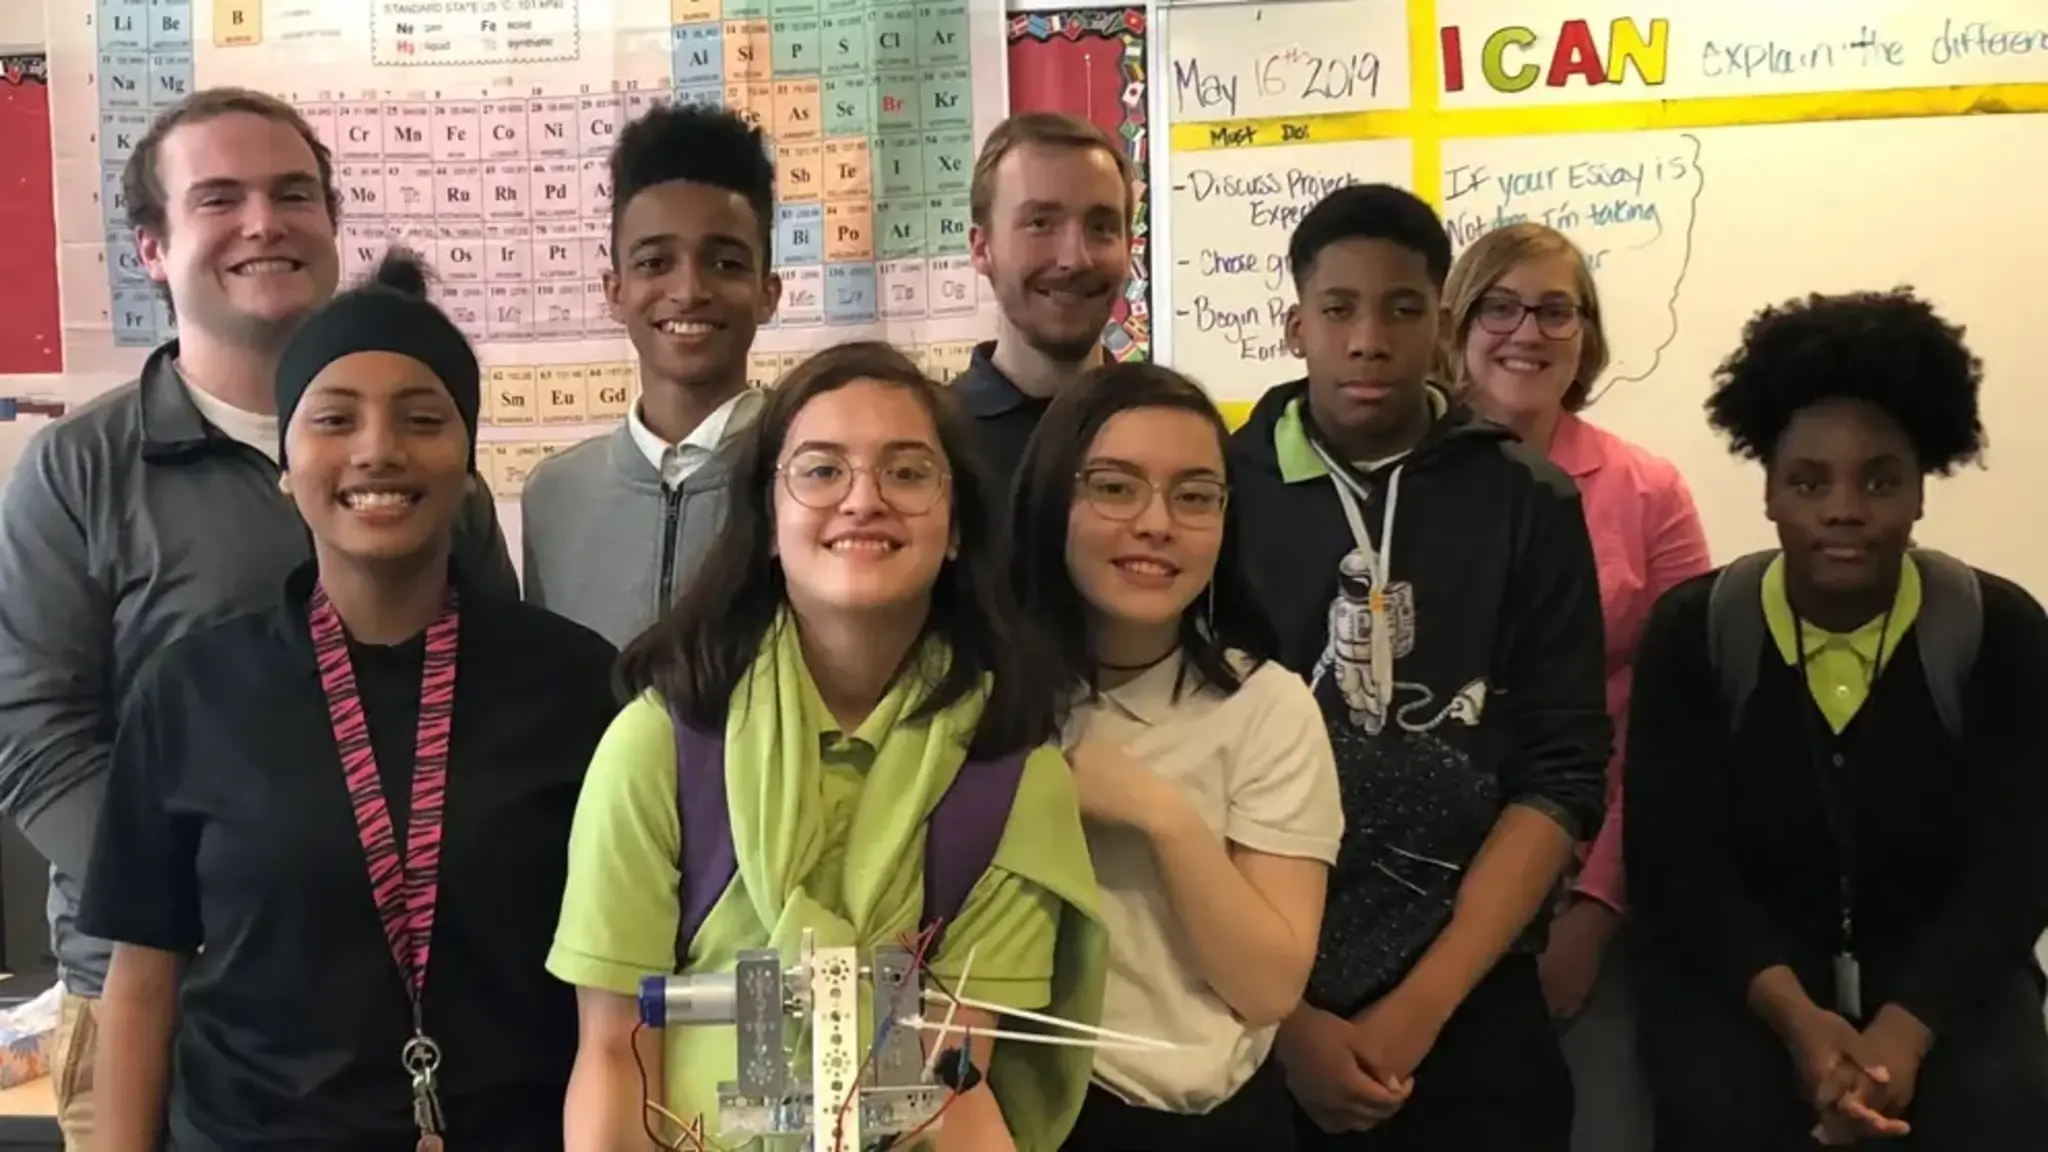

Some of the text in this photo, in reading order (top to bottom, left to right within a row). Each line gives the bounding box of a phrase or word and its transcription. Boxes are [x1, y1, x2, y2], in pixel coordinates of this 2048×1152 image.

[114, 16, 132, 31] Li
[162, 16, 180, 32] Be
[232, 10, 244, 26] B
[480, 19, 497, 32] Fe
[838, 36, 850, 54] S
[878, 32, 900, 48] Cl
[932, 30, 956, 46] Ar
[689, 50, 709, 66] Al
[737, 42, 754, 62] Si
[792, 44, 802, 58] P
[1440, 17, 1669, 93] I CAN
[1701, 40, 1834, 79] explain
[1848, 25, 1905, 67] the
[112, 76, 136, 90] Na
[160, 76, 184, 94] Mg
[1173, 57, 1238, 116] May
[1302, 51, 1380, 99] 2019
[882, 96, 904, 114] Br
[934, 92, 958, 108] Kr
[789, 106, 810, 122] As
[348, 126, 370, 142] Cr
[394, 126, 422, 142] Mn
[446, 126, 466, 142] Fe
[492, 124, 516, 142] Co
[544, 122, 564, 138] Ni
[590, 118, 613, 136] Cu
[116, 132, 130, 150] K
[1210, 125, 1258, 148] Must
[837, 162, 857, 180] Te
[893, 158, 900, 176] I
[938, 154, 962, 172] Xe
[790, 168, 811, 184] Sb
[1445, 155, 1687, 207] If your Essay is
[350, 186, 376, 202] Mo
[447, 186, 470, 202] Ru
[494, 184, 518, 202] Rh
[544, 183, 568, 200] Pd
[1188, 169, 1282, 202] Discuss
[890, 222, 910, 240] At
[940, 218, 964, 234] Rn
[1446, 211, 1487, 248] Not
[1542, 200, 1580, 230] I'm
[792, 228, 810, 246] Bi
[837, 224, 860, 242] Po
[357, 246, 374, 262] W
[450, 247, 472, 263] Os
[500, 246, 515, 262] Ir
[550, 244, 567, 260] Pt
[1201, 248, 1258, 277] Choose
[124, 310, 144, 328] Fr
[1194, 295, 1260, 344] Begin
[500, 390, 525, 408] Sm
[551, 390, 574, 406] Eu
[599, 388, 627, 404] Gd
